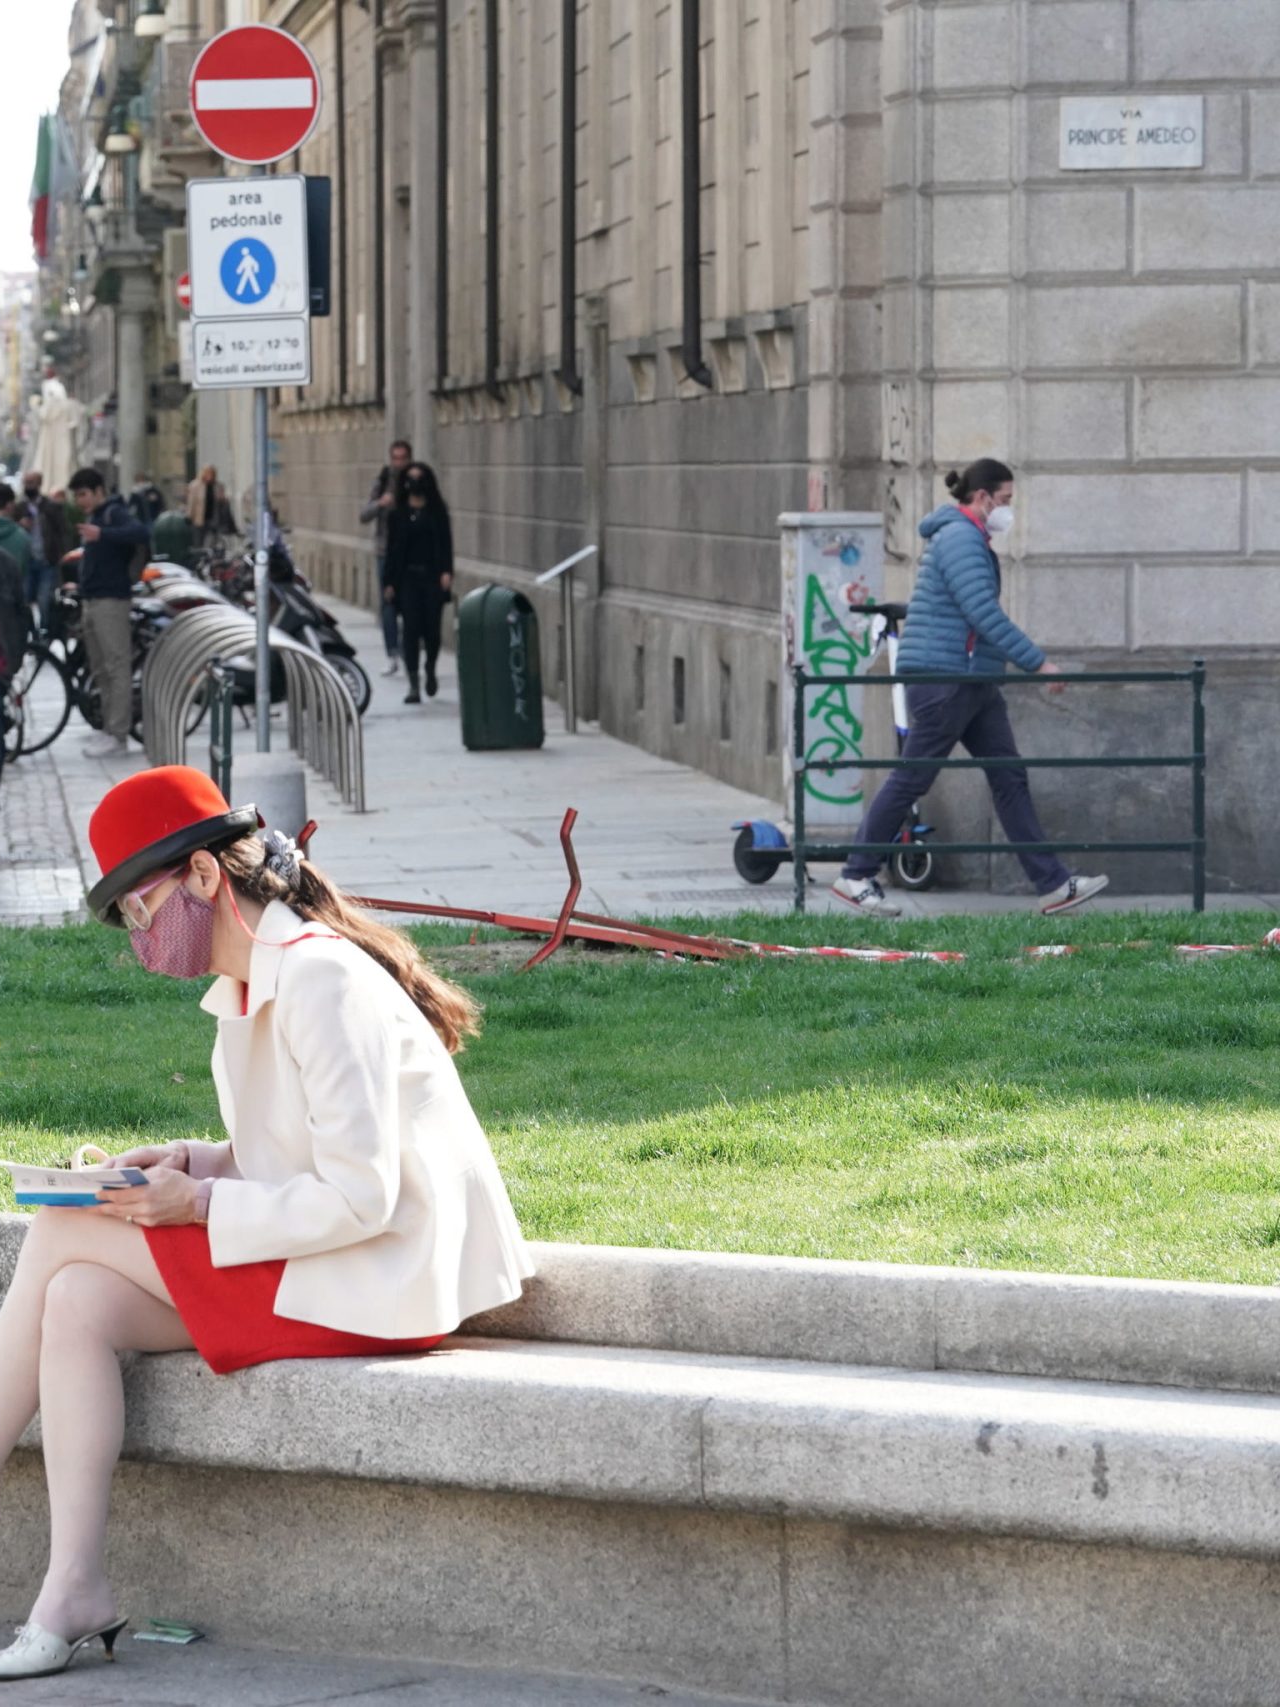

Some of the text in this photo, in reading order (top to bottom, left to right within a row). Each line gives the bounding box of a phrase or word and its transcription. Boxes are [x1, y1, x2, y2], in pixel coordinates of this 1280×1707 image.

[1120, 109, 1142, 119] VIA
[1068, 127, 1196, 146] PRINCIPE AMEDEO
[228, 193, 262, 206] area
[210, 212, 283, 231] pedonale
[200, 361, 303, 376] veicoli autorizzati
